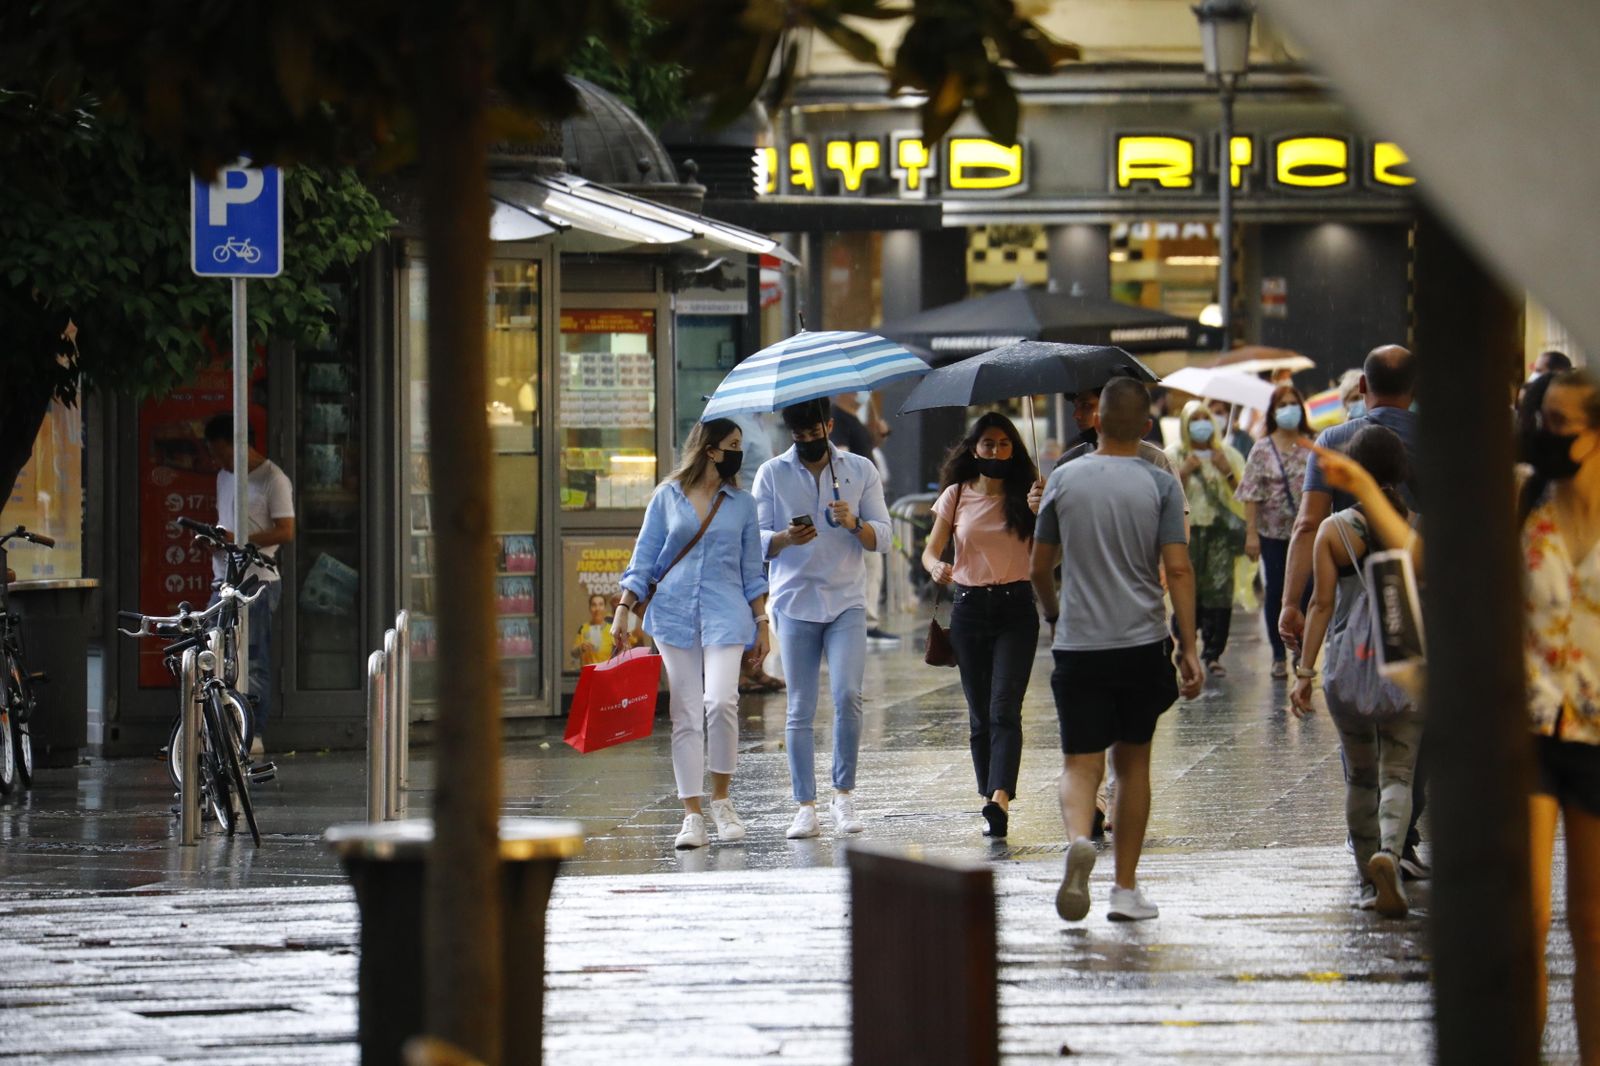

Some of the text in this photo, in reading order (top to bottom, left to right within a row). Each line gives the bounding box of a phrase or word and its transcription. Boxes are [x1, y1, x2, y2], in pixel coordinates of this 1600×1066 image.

[208, 157, 264, 226] P
[186, 494, 204, 509] 17
[188, 548, 202, 563] 2
[582, 549, 631, 560] CUANDO
[576, 560, 618, 571] JUEGAS
[186, 575, 203, 590] 11
[578, 572, 622, 584] JUGAM
[586, 583, 621, 595] TODO
